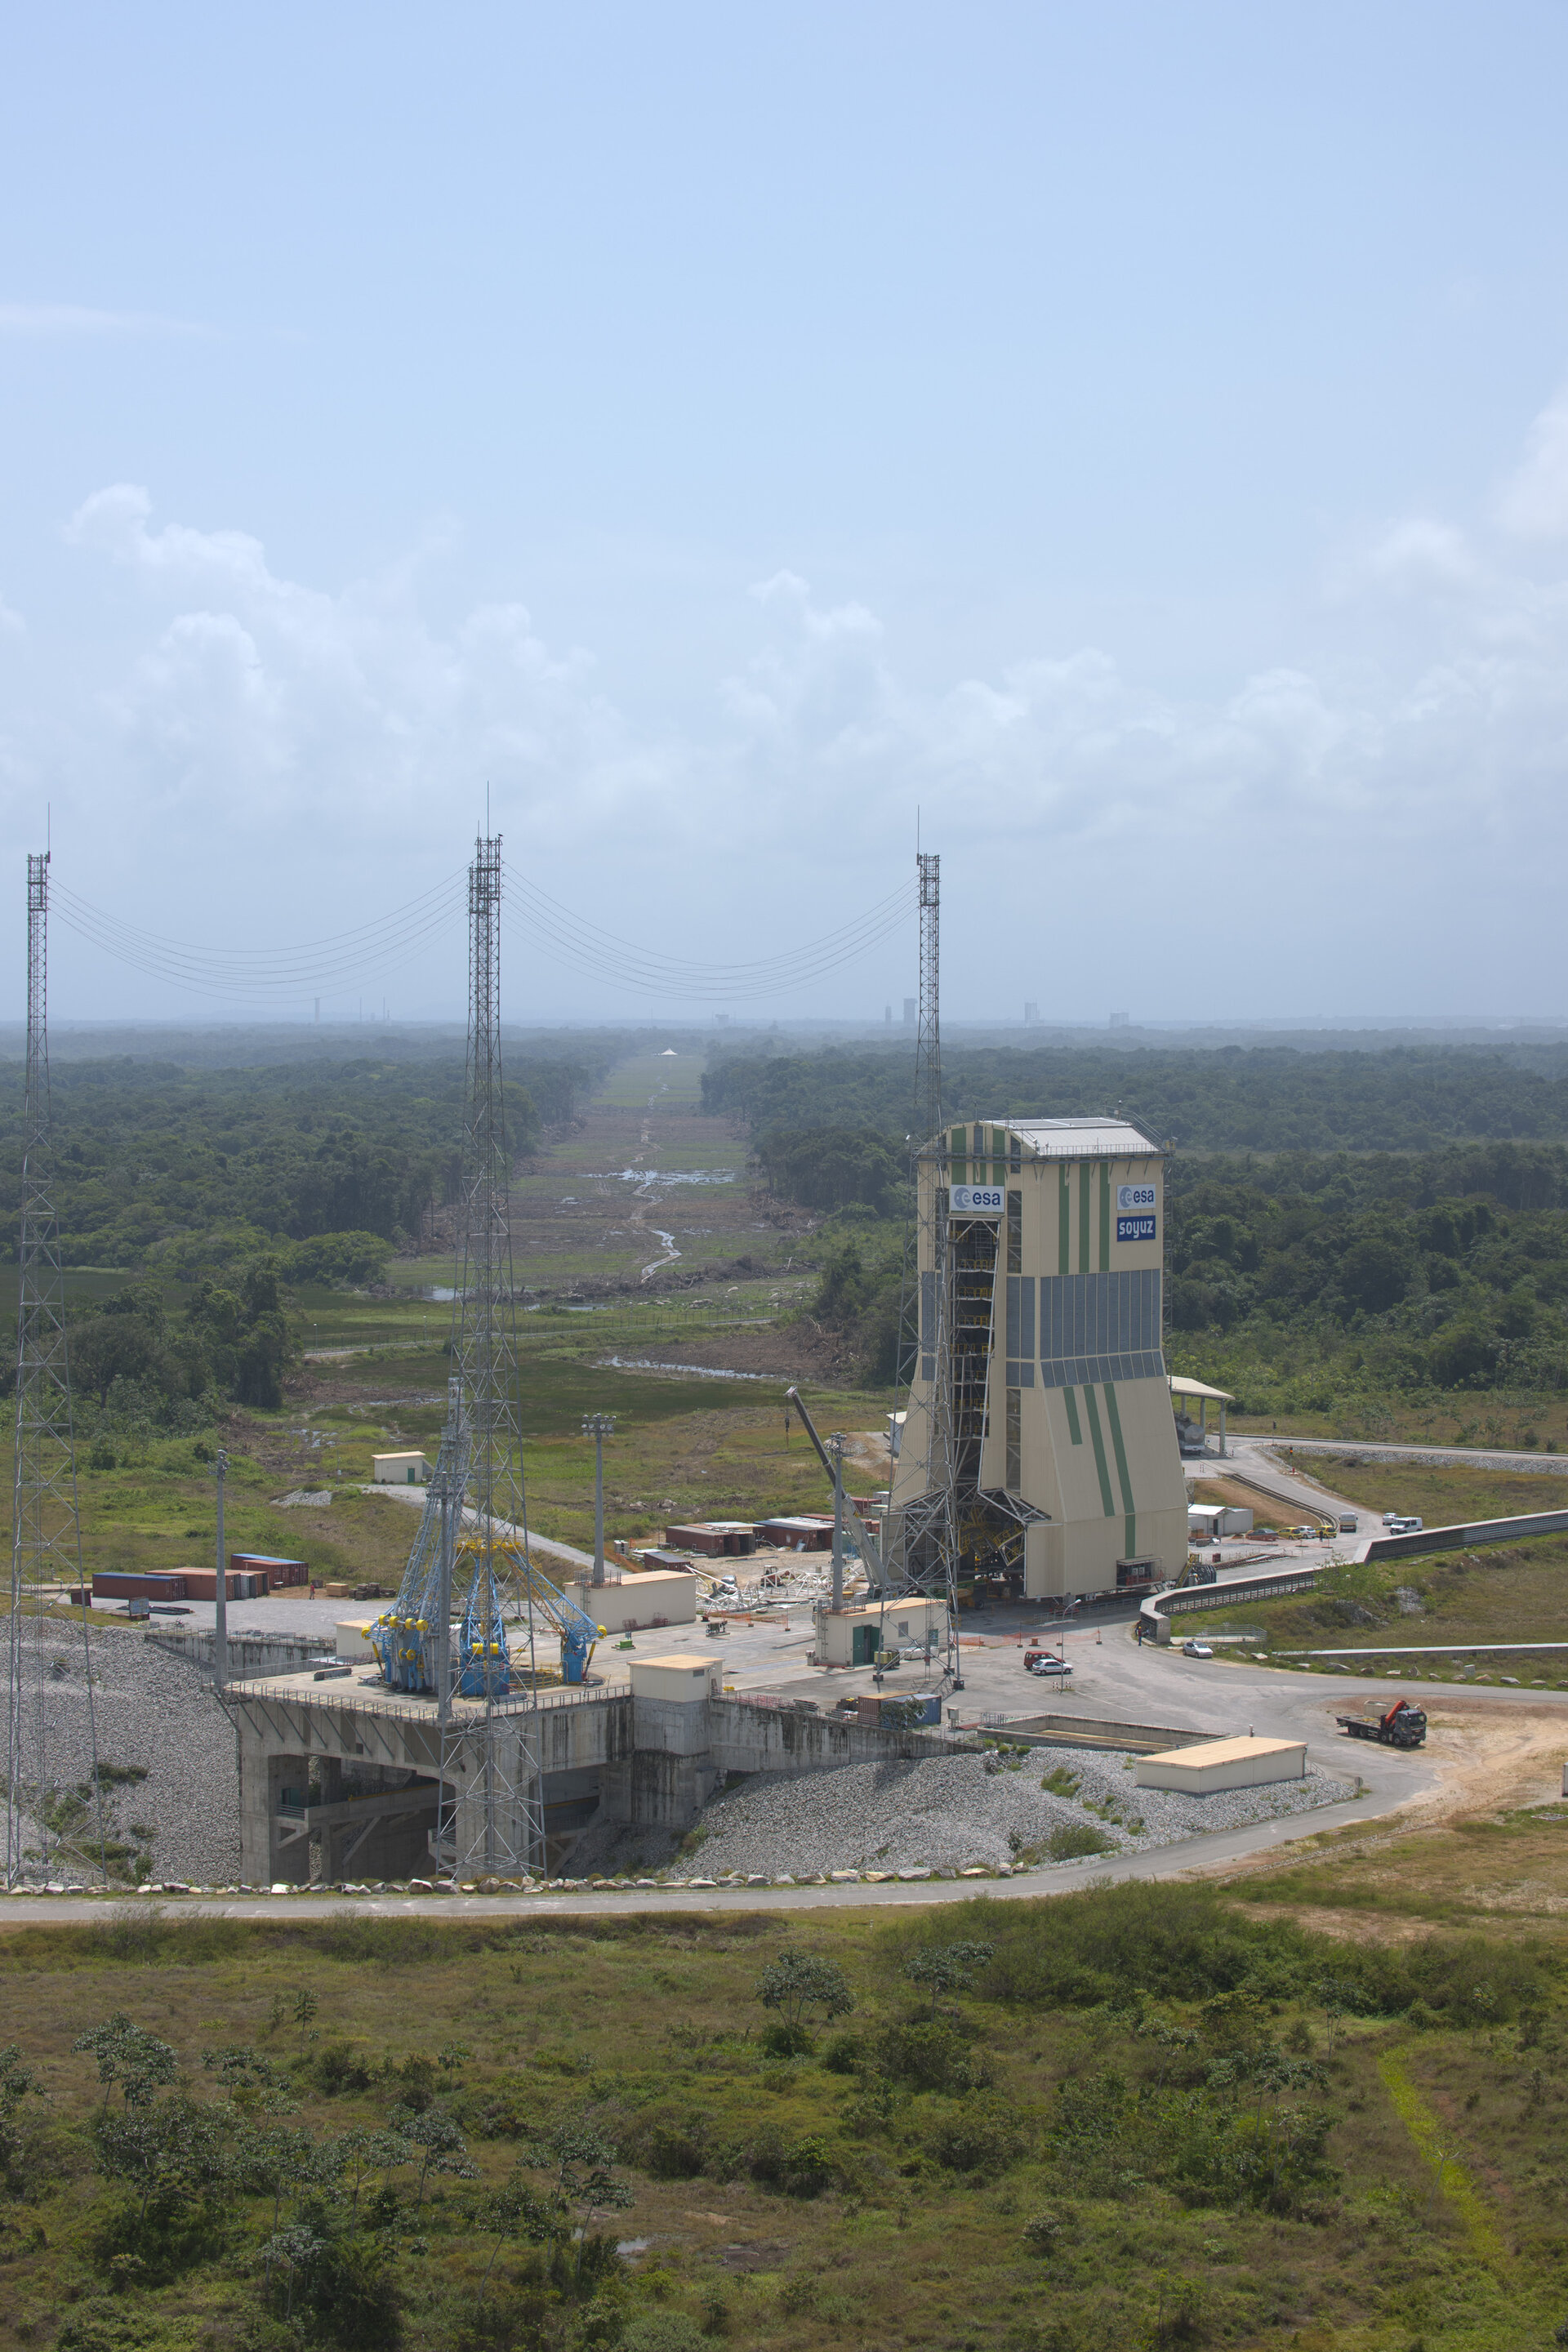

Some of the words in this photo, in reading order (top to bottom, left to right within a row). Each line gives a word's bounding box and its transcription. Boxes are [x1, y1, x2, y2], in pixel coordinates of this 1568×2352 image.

[973, 1192, 1000, 1206] esa
[1133, 1189, 1154, 1203] esa
[1119, 1220, 1153, 1239] soyuz
